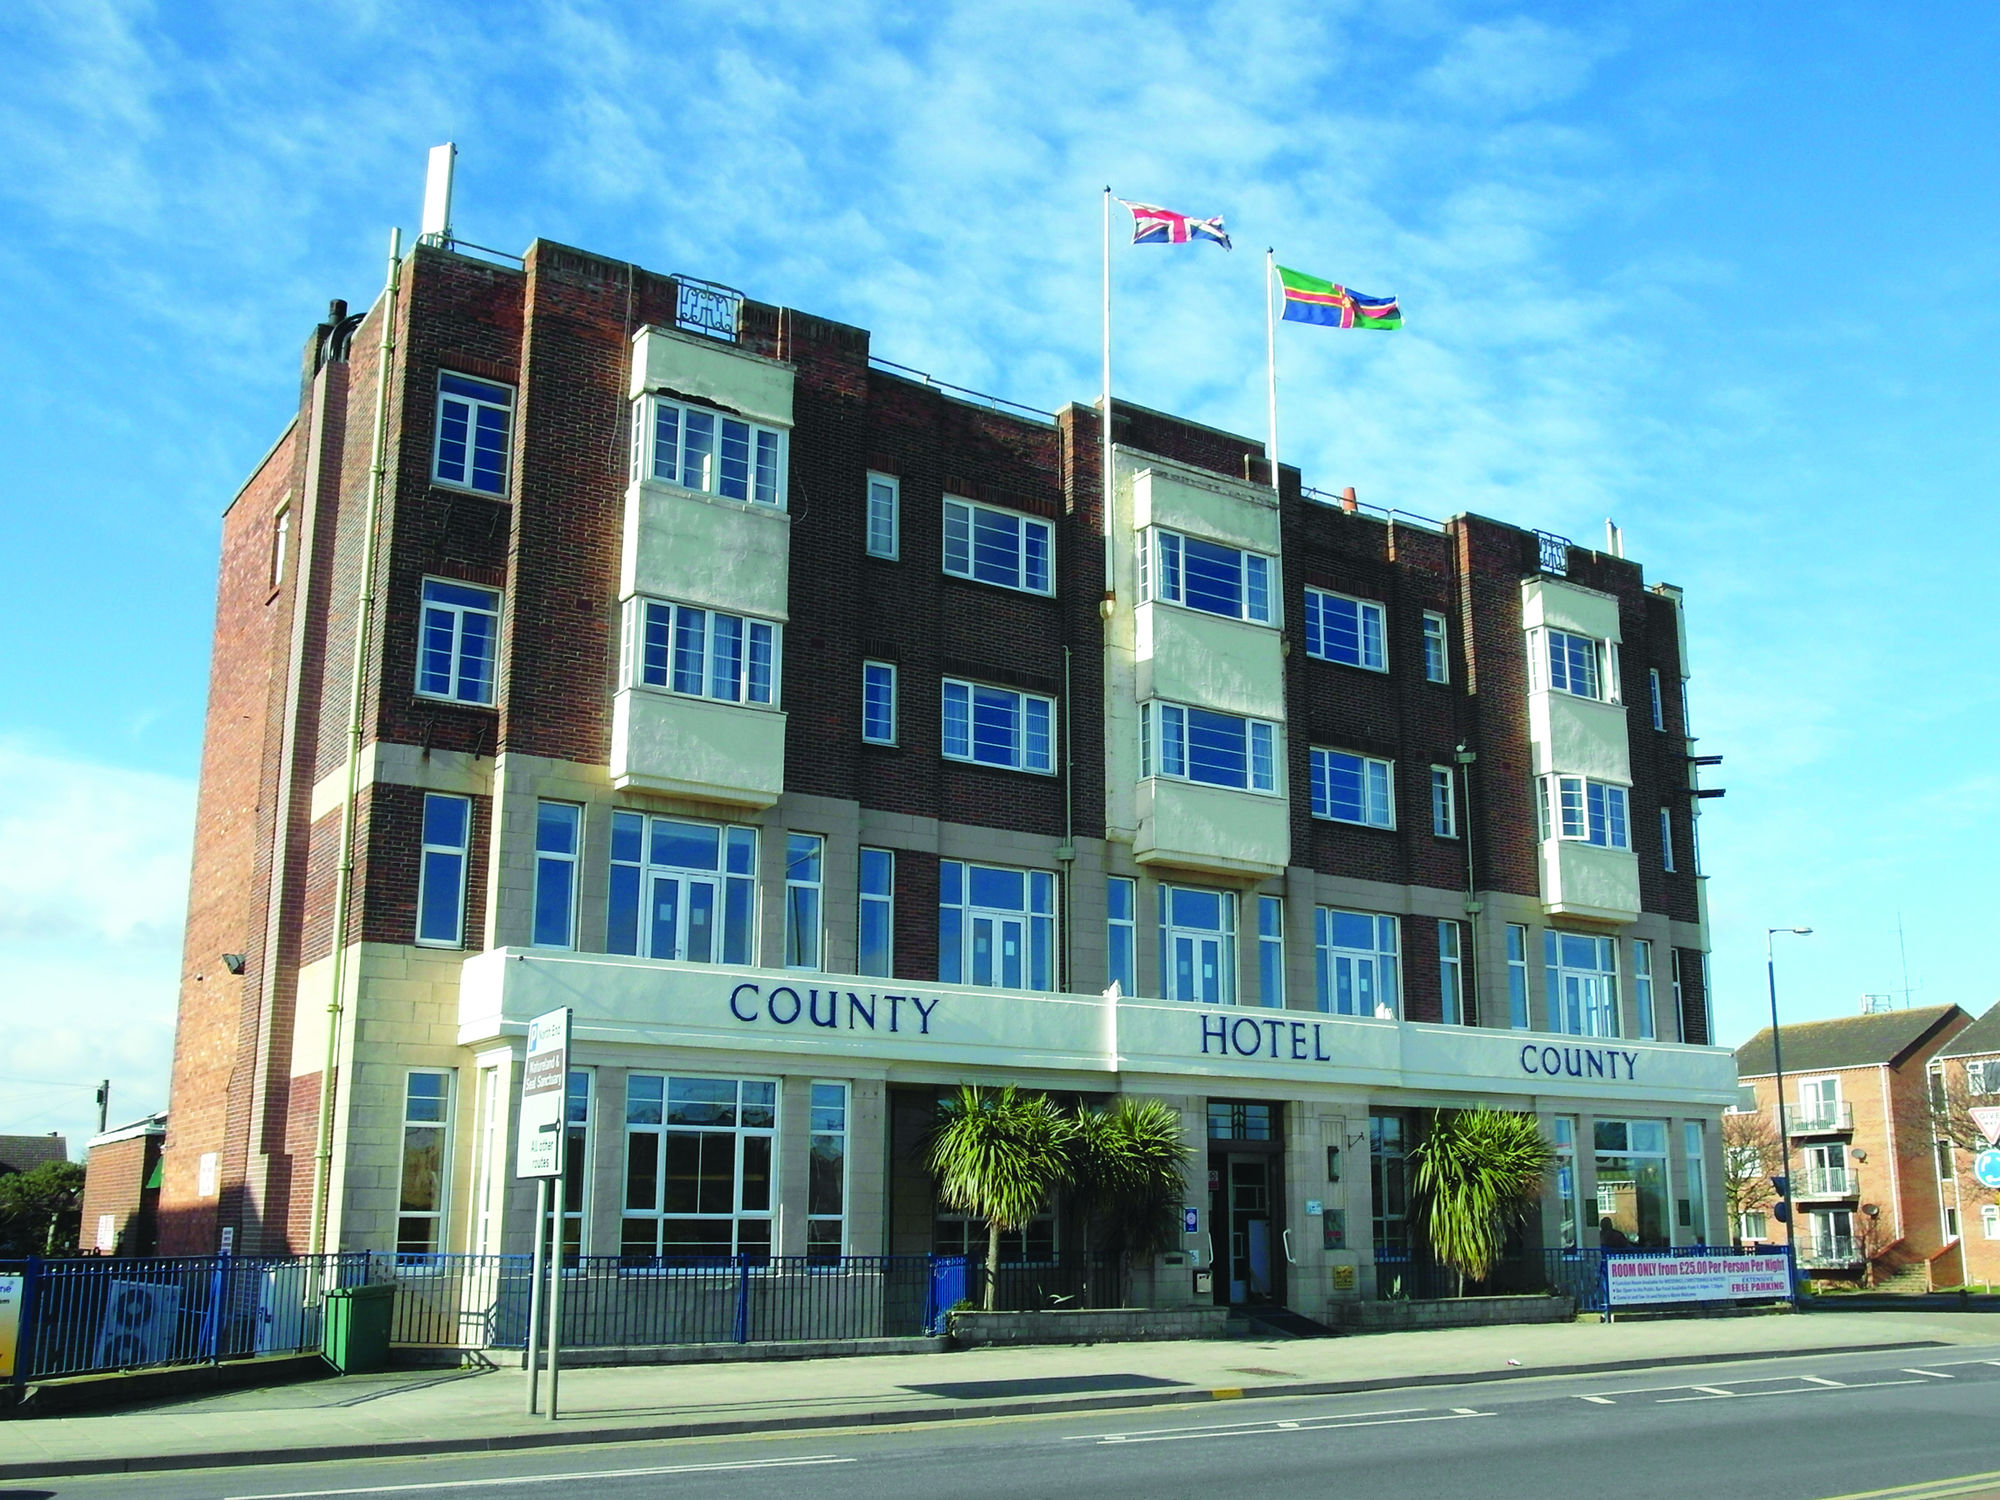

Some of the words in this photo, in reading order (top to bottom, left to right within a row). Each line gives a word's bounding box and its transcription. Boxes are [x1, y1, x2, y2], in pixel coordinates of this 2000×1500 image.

[730, 983, 939, 1034] COUNTY
[1201, 1015, 1331, 1061] HOTEL
[529, 1056, 555, 1074] Natureland
[1521, 1045, 1639, 1080] COUNTY
[526, 1076, 537, 1091] Seal
[537, 1072, 562, 1088] Sanctuary
[1978, 1112, 2000, 1121] GIVE
[1611, 1263, 1637, 1277] ROOM
[1637, 1262, 1657, 1277] ONLY
[1658, 1262, 1678, 1276] from
[1679, 1260, 1707, 1275] £25.00
[1708, 1260, 1722, 1274] Per
[1722, 1260, 1750, 1274] Person
[1750, 1259, 1764, 1272] Per
[1764, 1258, 1785, 1273] Night
[1731, 1283, 1750, 1292] FREE
[1750, 1281, 1785, 1291] PARKING
